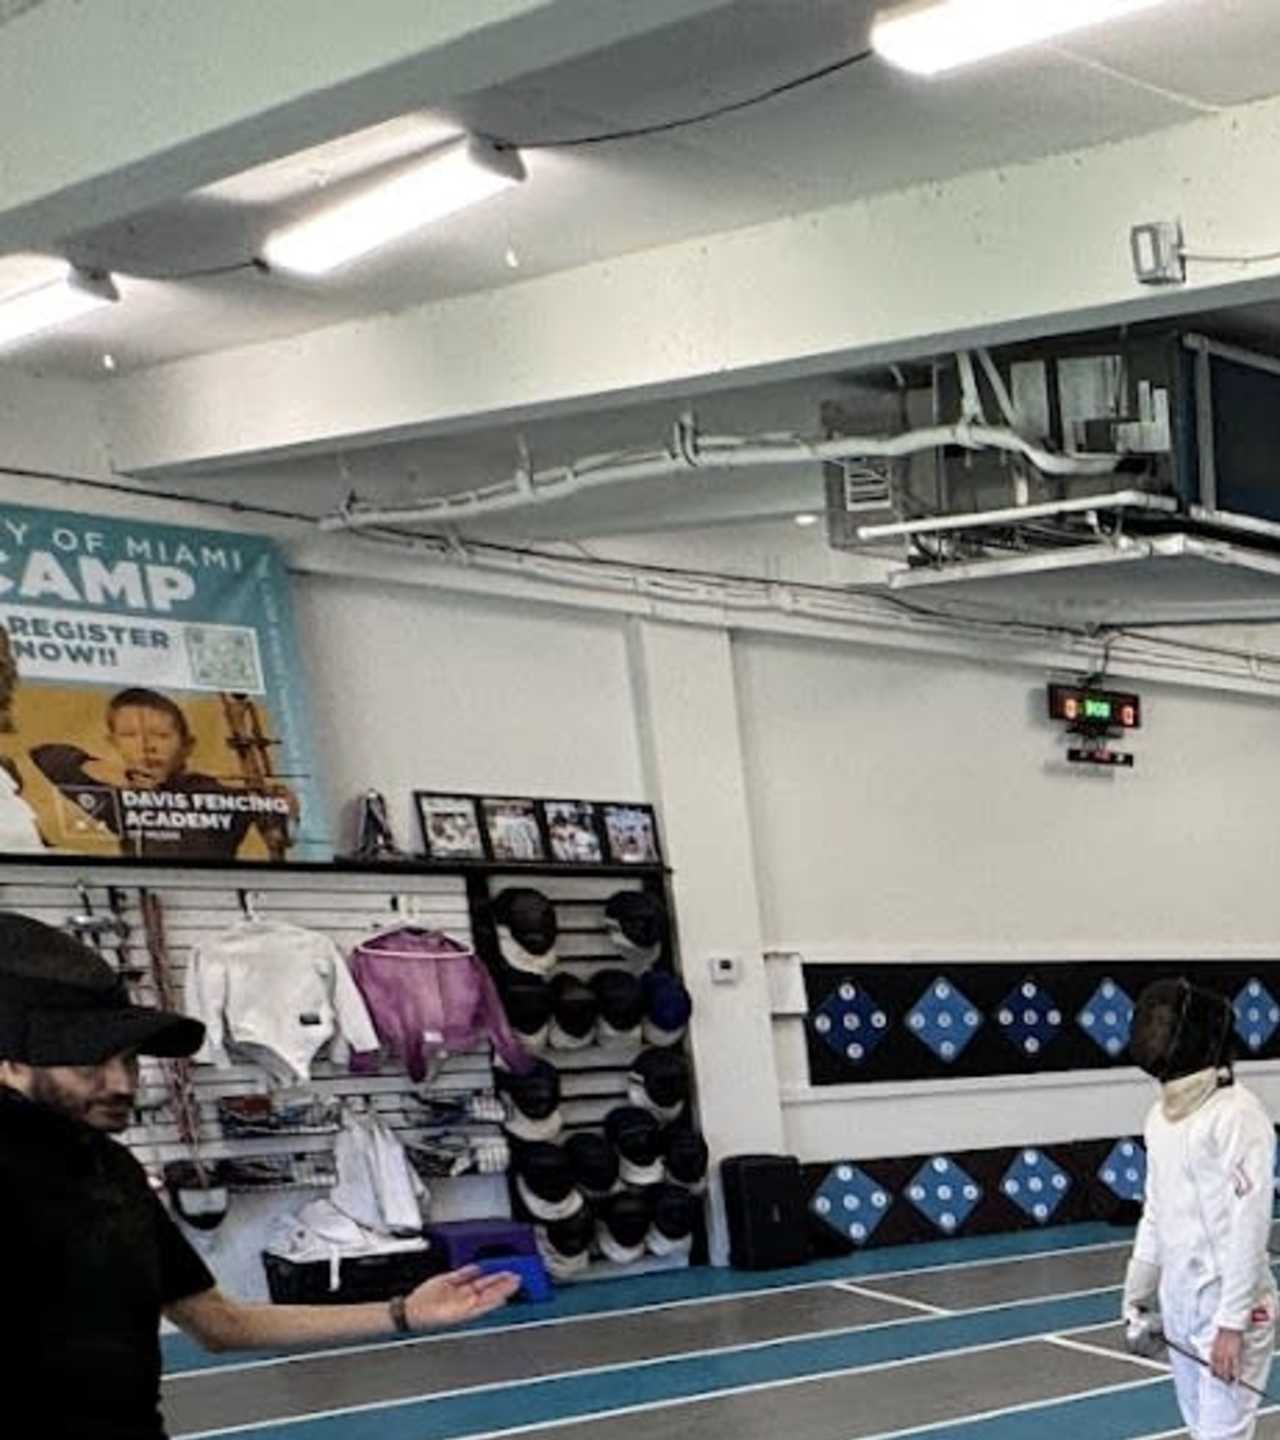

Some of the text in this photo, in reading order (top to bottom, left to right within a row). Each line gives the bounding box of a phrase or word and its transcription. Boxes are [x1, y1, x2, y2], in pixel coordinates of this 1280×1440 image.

[52, 528, 104, 552] OF
[126, 535, 242, 571] MIAMI
[7, 615, 170, 649] REGISTER
[13, 640, 118, 667] NOW!!
[121, 789, 290, 815] DAVIS FENCING
[125, 810, 234, 830] ACADEMY
